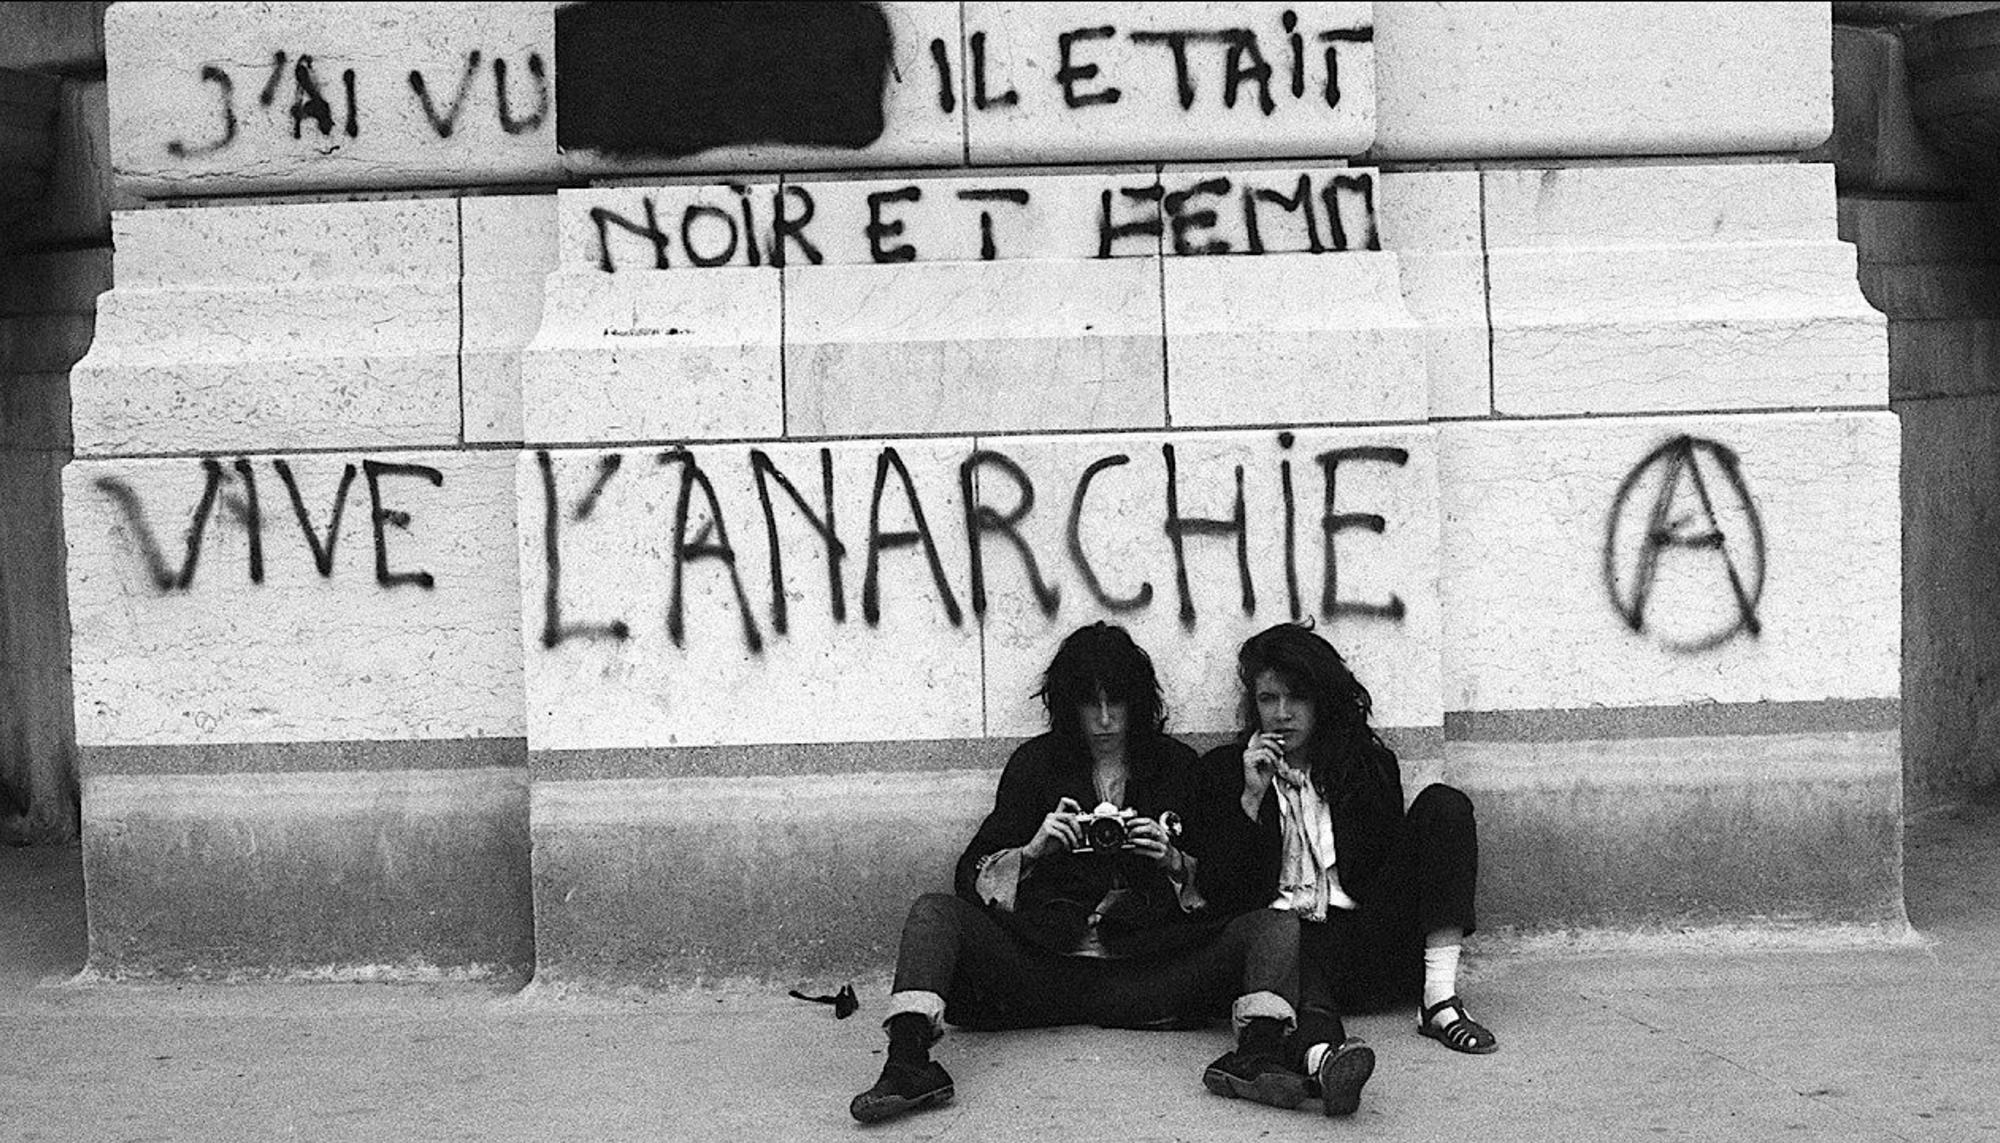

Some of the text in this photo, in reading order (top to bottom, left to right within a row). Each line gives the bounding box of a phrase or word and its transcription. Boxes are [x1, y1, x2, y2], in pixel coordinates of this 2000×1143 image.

[166, 48, 549, 157] J'AI VU
[930, 30, 1018, 113] IL
[866, 186, 1029, 262] ET
[97, 456, 444, 590] VIVE
